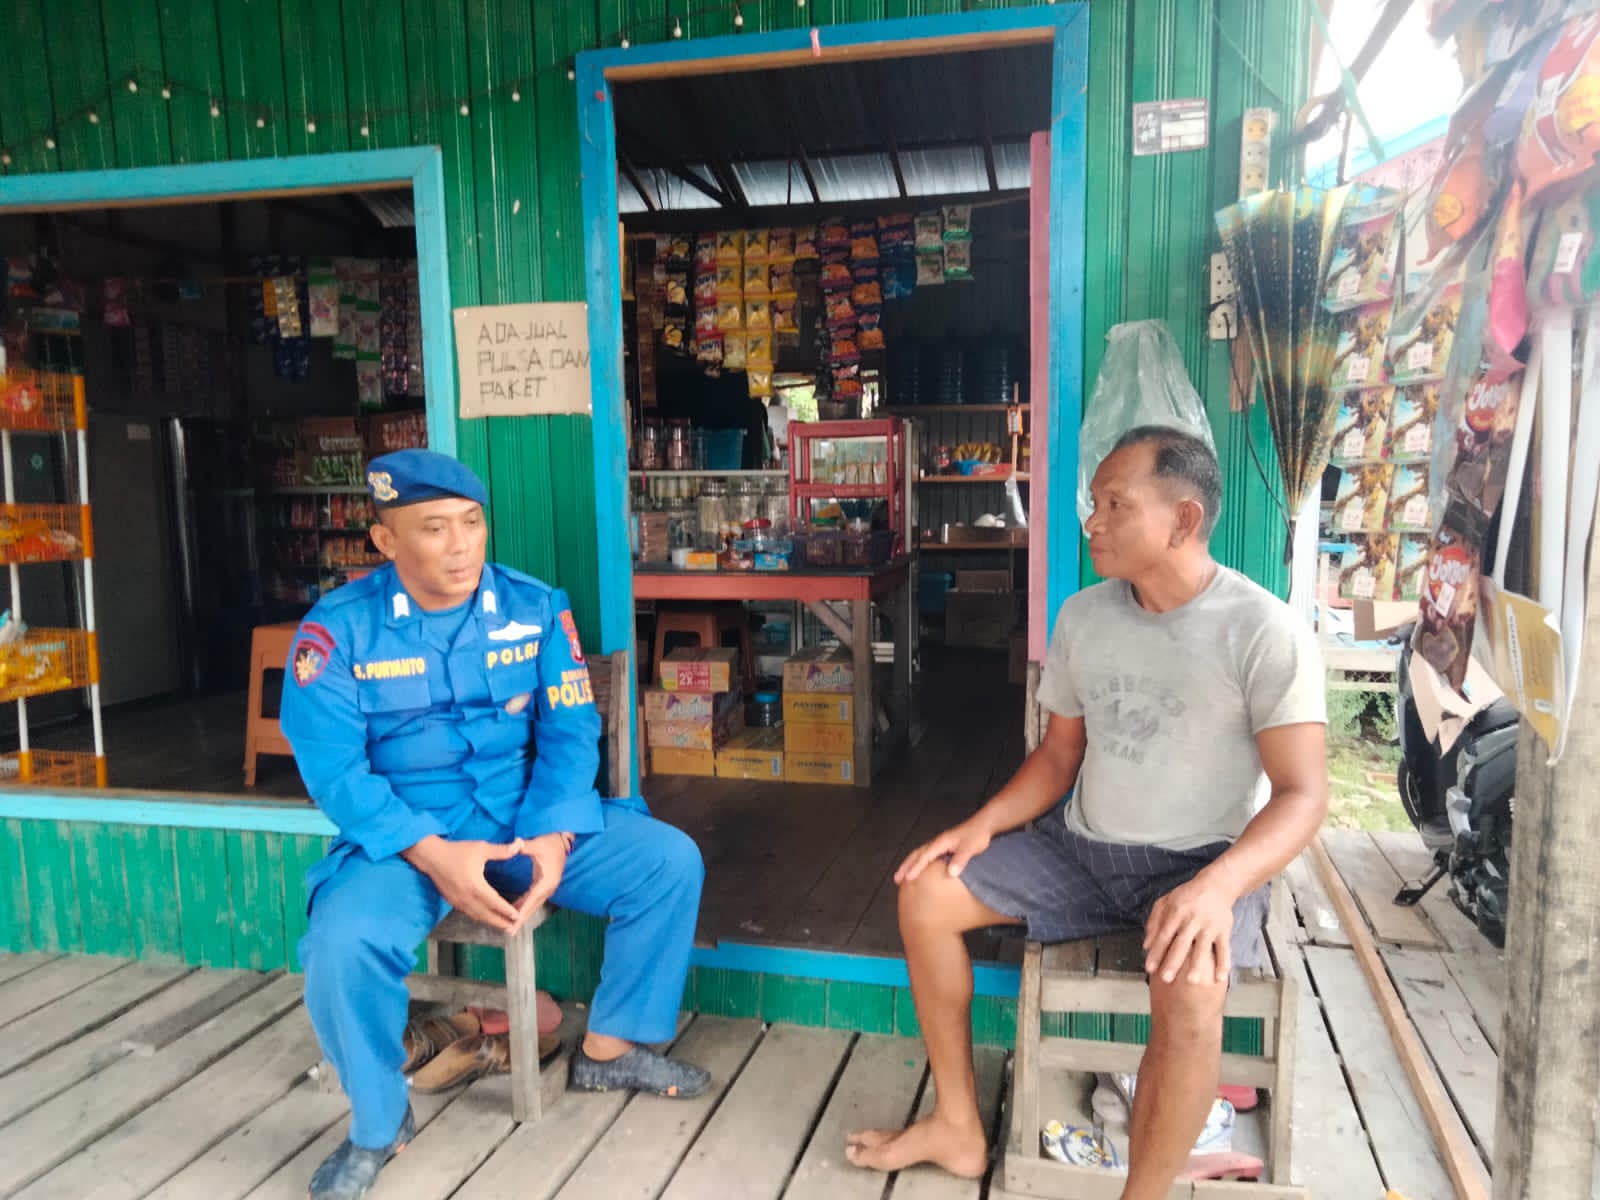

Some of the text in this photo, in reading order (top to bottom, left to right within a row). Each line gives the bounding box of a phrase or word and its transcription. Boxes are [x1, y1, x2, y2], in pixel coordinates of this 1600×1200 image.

[477, 319, 567, 345] ADA JUAL
[477, 347, 544, 376] PULSA
[479, 376, 547, 405] PAKET
